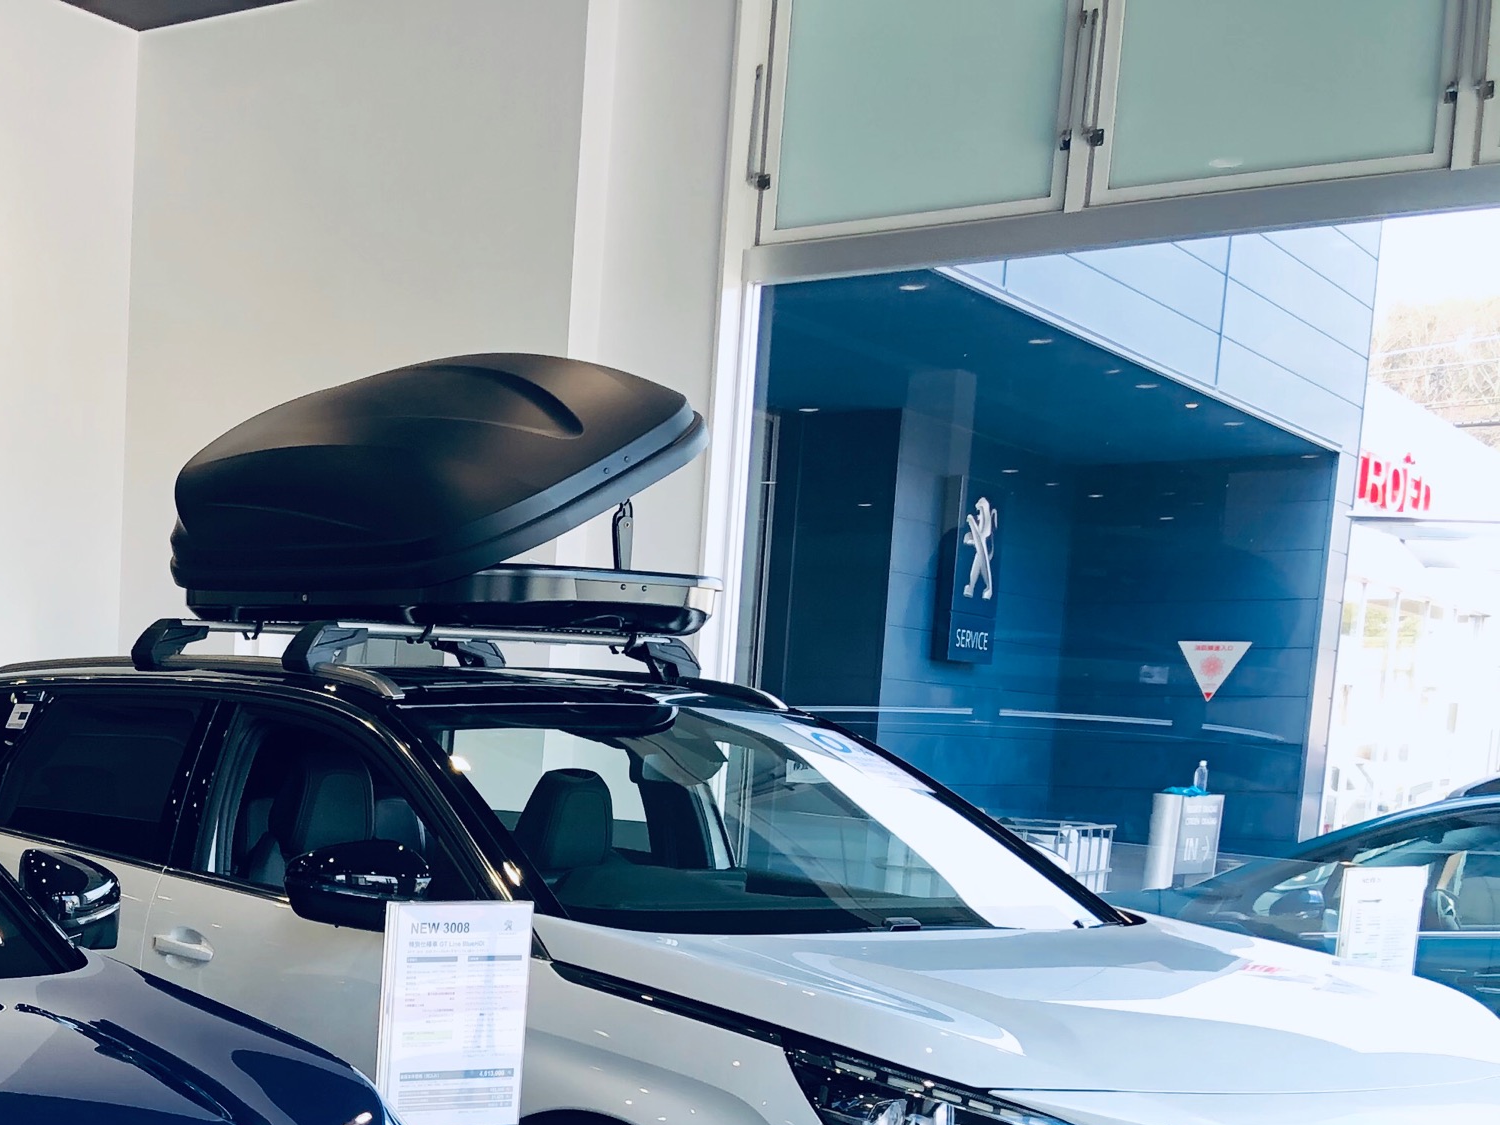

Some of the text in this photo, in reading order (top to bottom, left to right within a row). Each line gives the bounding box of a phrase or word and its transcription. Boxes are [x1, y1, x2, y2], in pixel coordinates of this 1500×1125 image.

[955, 628, 989, 651] SERVICE
[410, 921, 470, 935] NEW 3008
